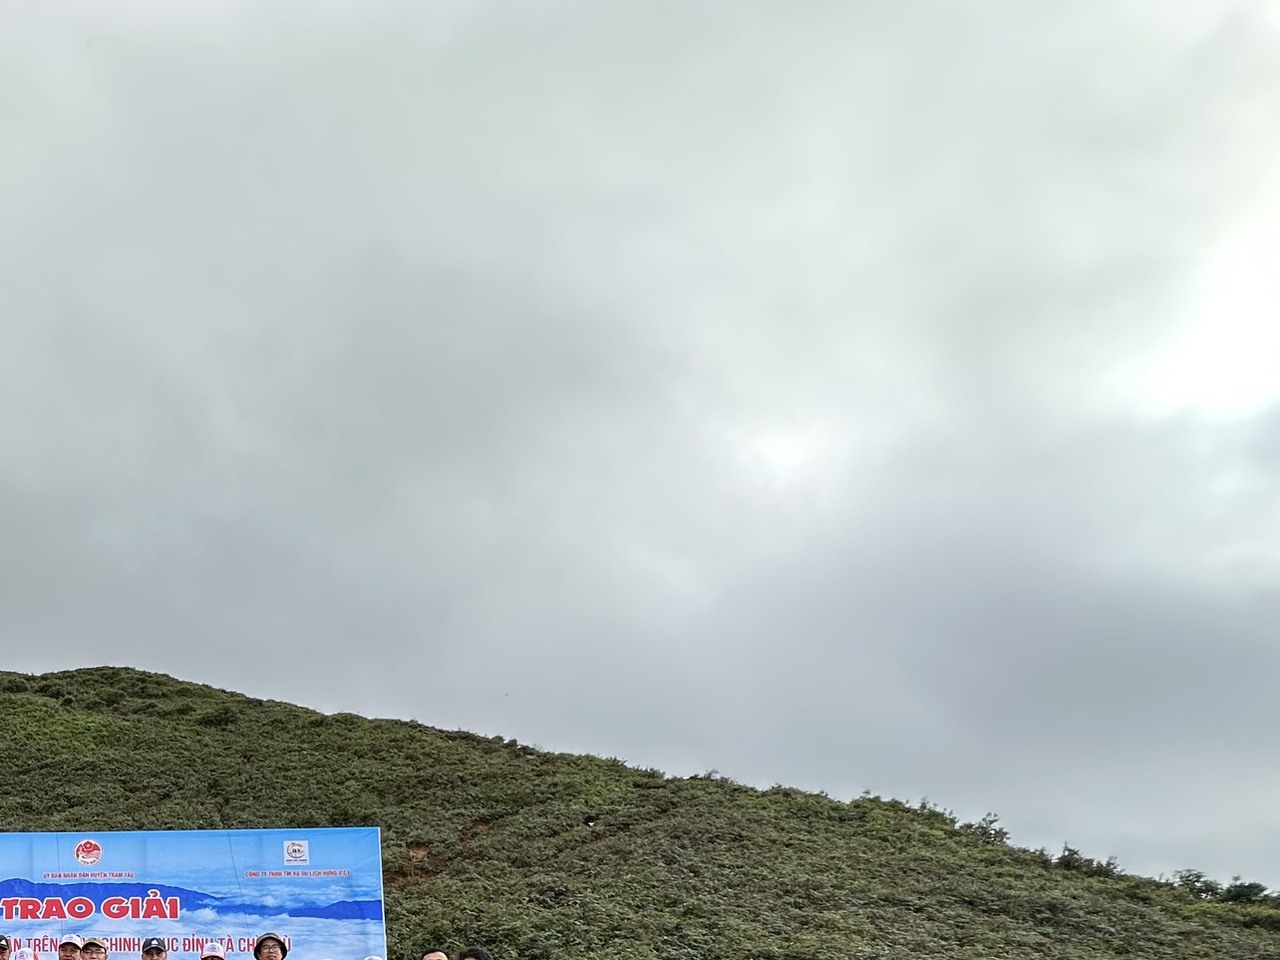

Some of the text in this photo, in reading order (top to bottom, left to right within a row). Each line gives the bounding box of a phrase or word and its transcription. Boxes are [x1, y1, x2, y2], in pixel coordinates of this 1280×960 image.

[1, 890, 180, 920] TRAO GIẢI
[25, 935, 58, 952] TRÊN
